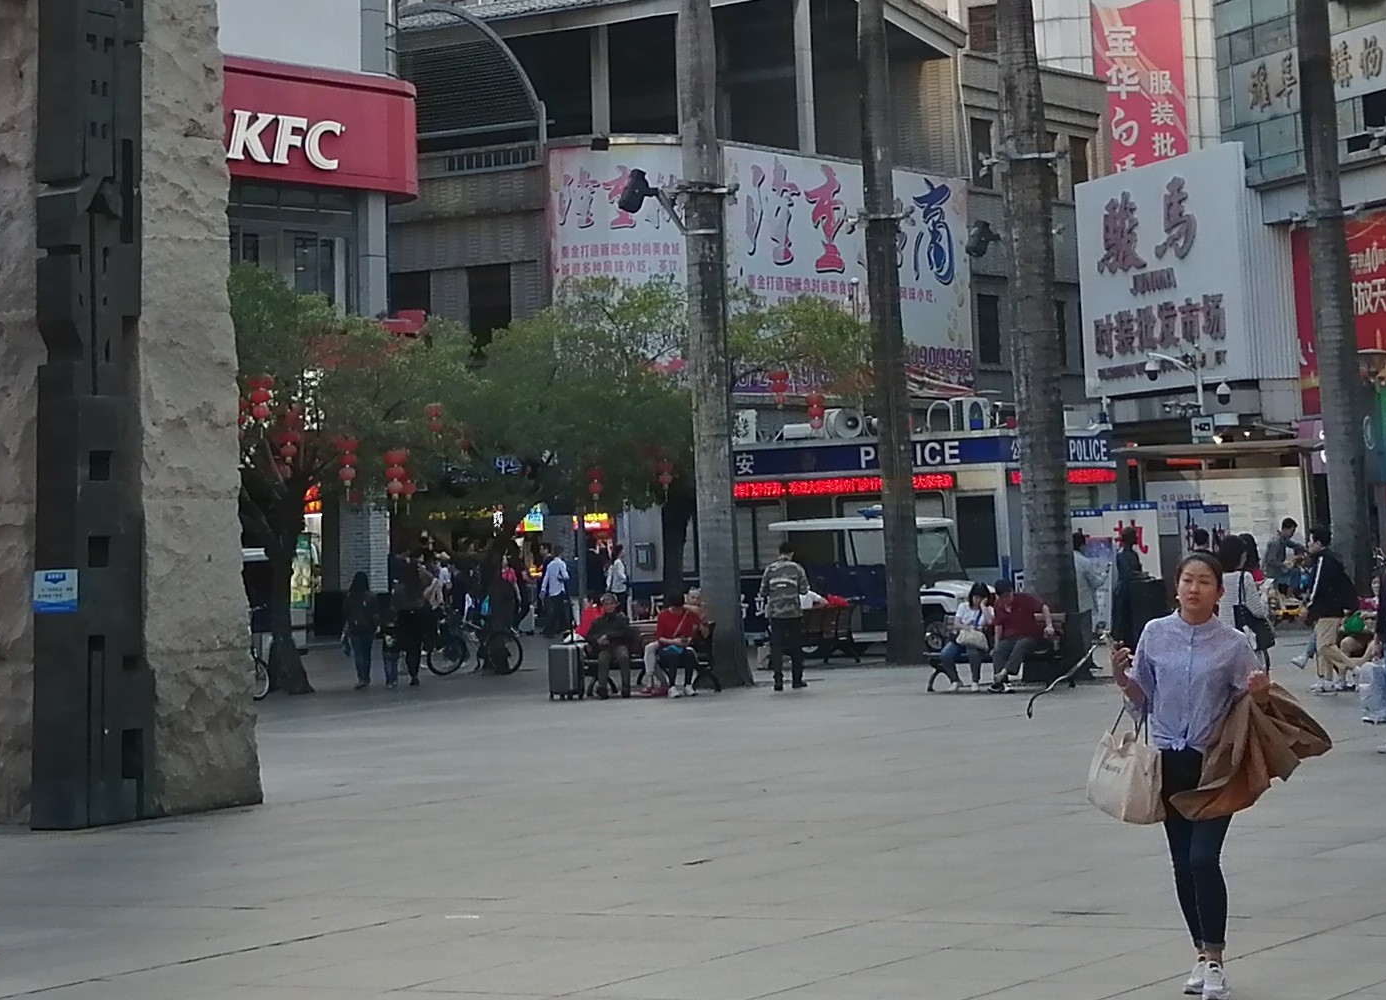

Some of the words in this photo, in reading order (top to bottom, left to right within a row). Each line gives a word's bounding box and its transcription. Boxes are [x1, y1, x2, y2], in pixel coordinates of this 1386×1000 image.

[227, 109, 346, 170] KFC
[1093, 294, 1227, 359] 时装批发市场
[735, 453, 755, 475] 安
[1068, 439, 1108, 461] POLICE
